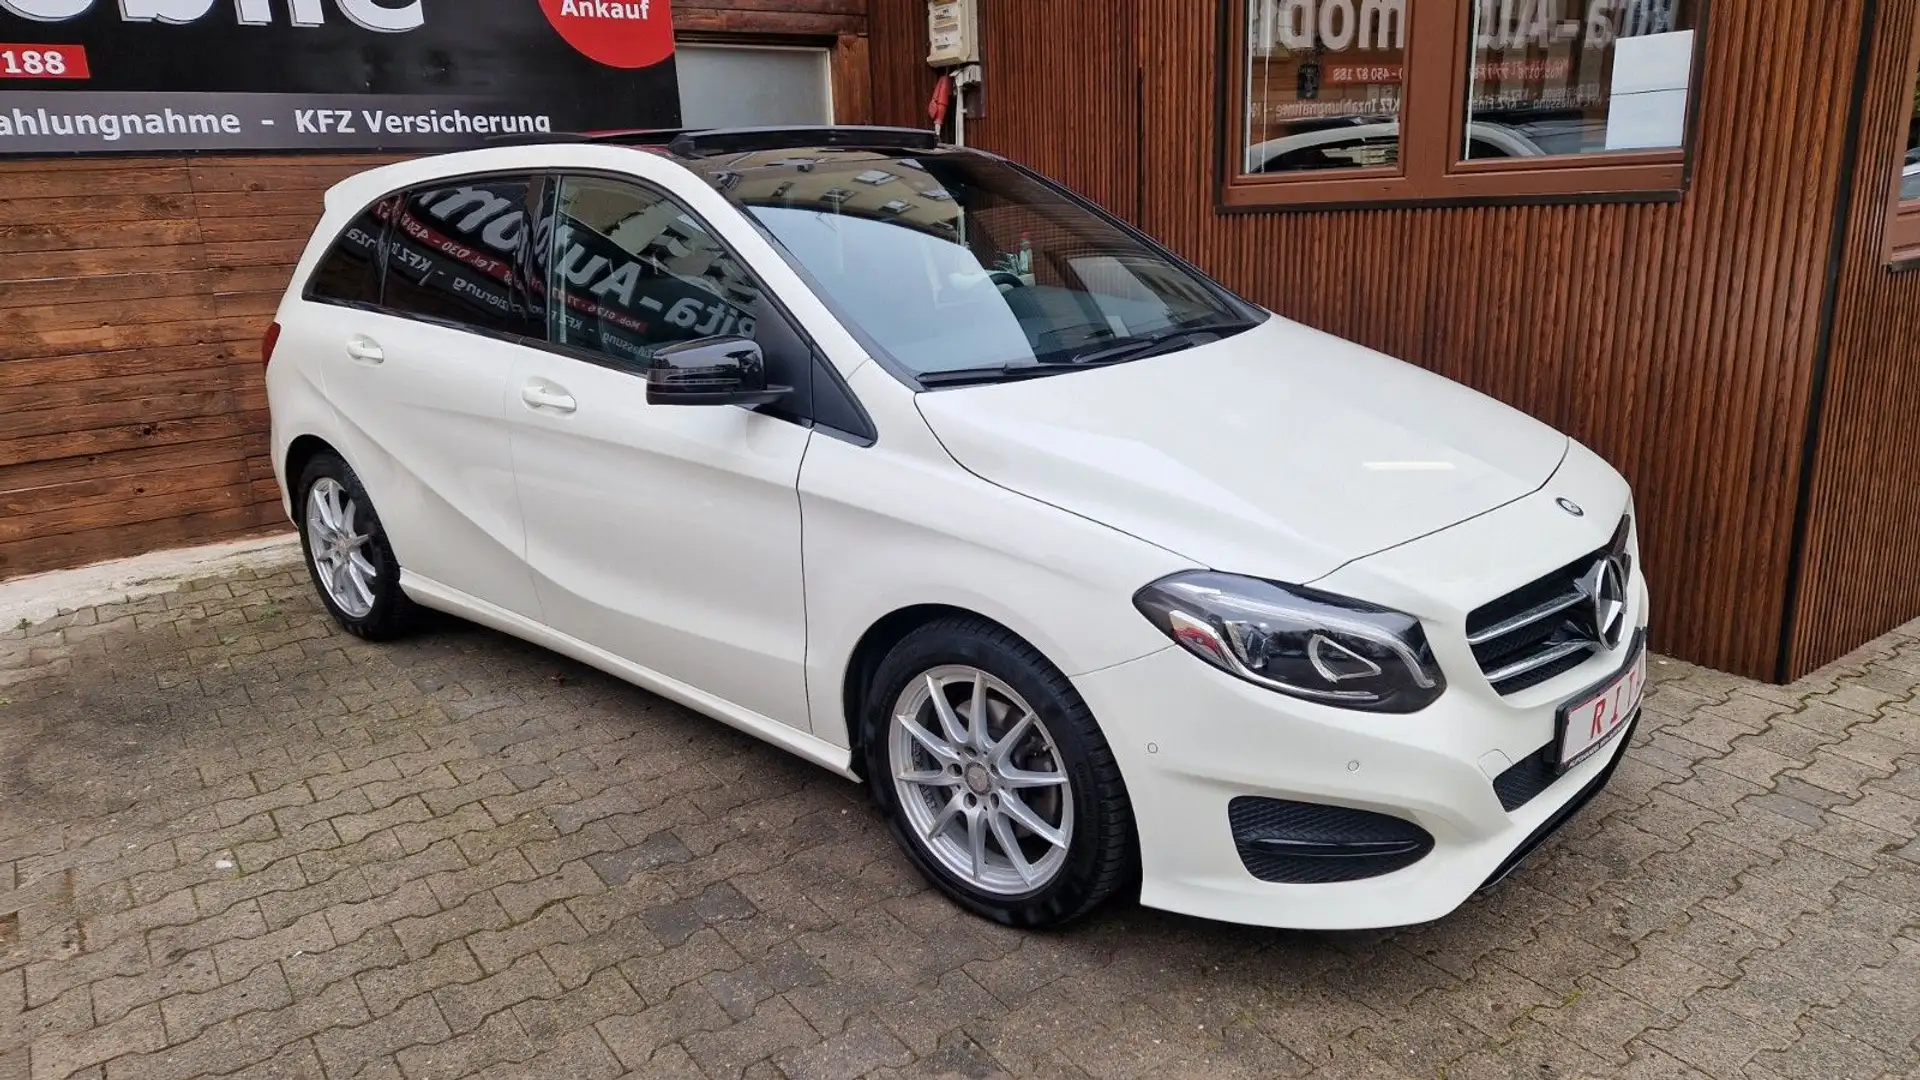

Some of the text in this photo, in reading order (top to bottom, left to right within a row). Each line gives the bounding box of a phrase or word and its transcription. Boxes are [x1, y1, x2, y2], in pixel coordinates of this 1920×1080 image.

[560, 0, 649, 20] Ankauf
[2, 50, 67, 75] 188
[294, 109, 355, 134] KFZ
